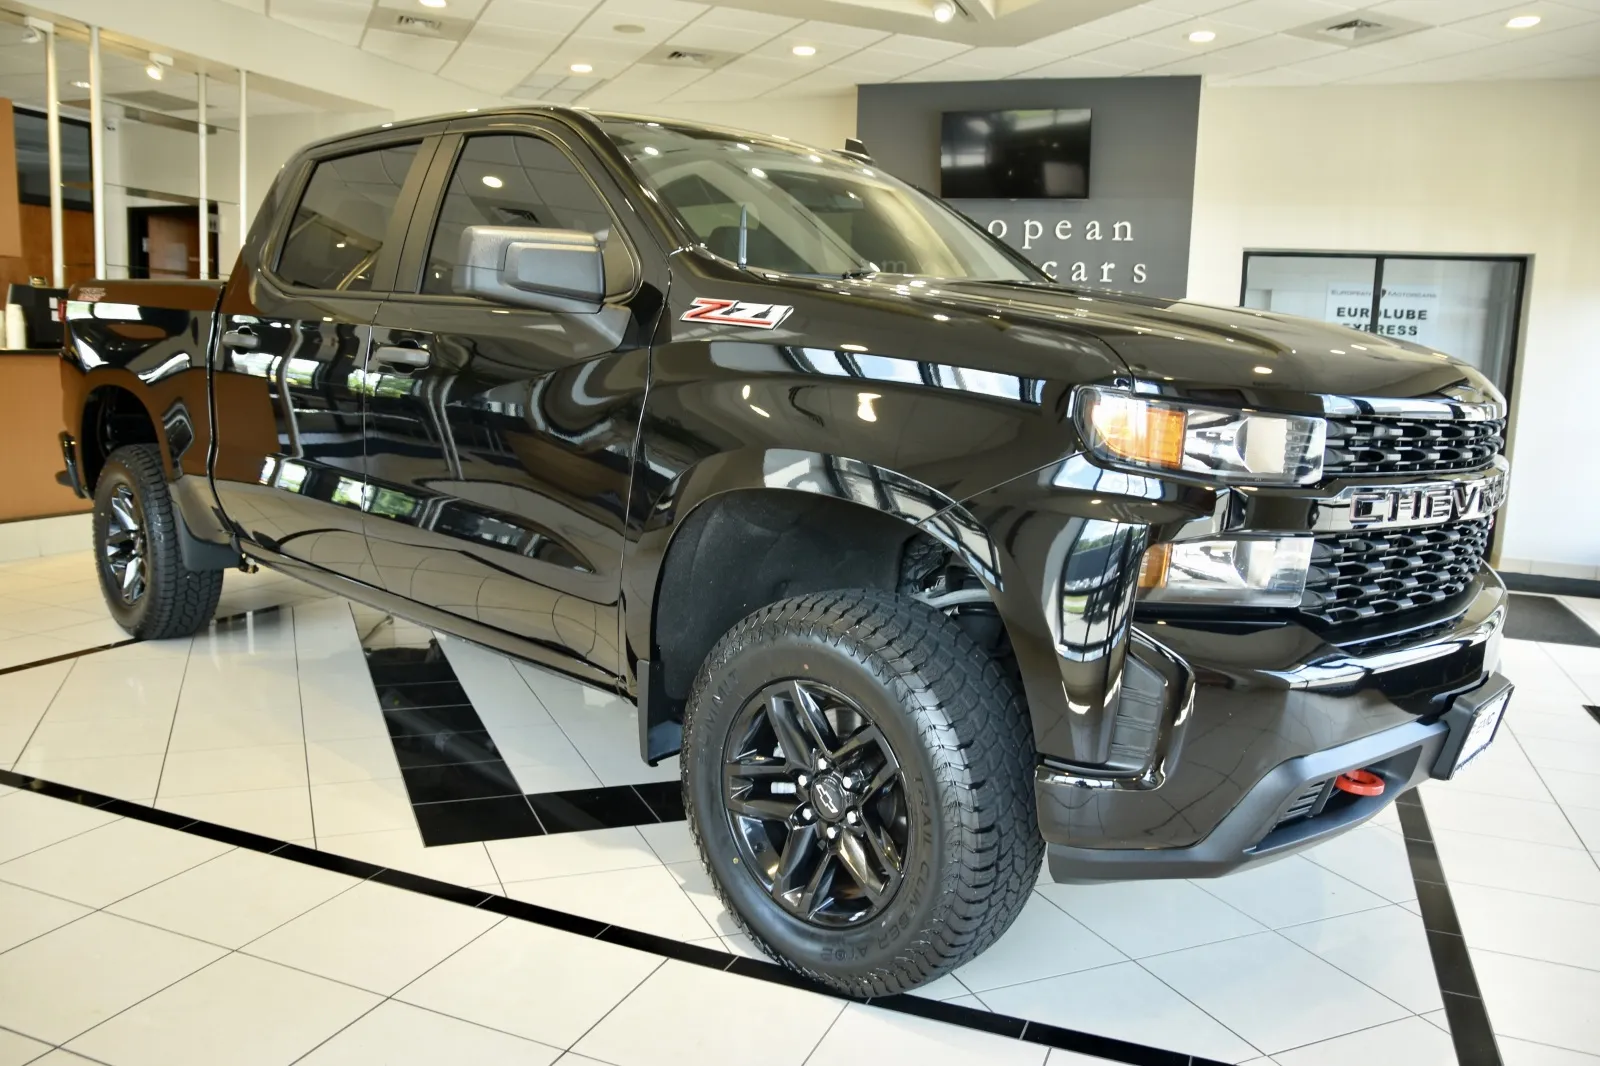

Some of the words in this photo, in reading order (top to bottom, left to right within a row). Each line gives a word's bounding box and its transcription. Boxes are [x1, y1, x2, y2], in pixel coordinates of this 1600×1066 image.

[988, 218, 1134, 249] opean
[1041, 260, 1148, 283] cars
[679, 297, 794, 331] Z71
[1336, 306, 1428, 320] EURLUBE
[1343, 322, 1417, 335] XPRESS
[913, 770, 933, 850] TRAIL
